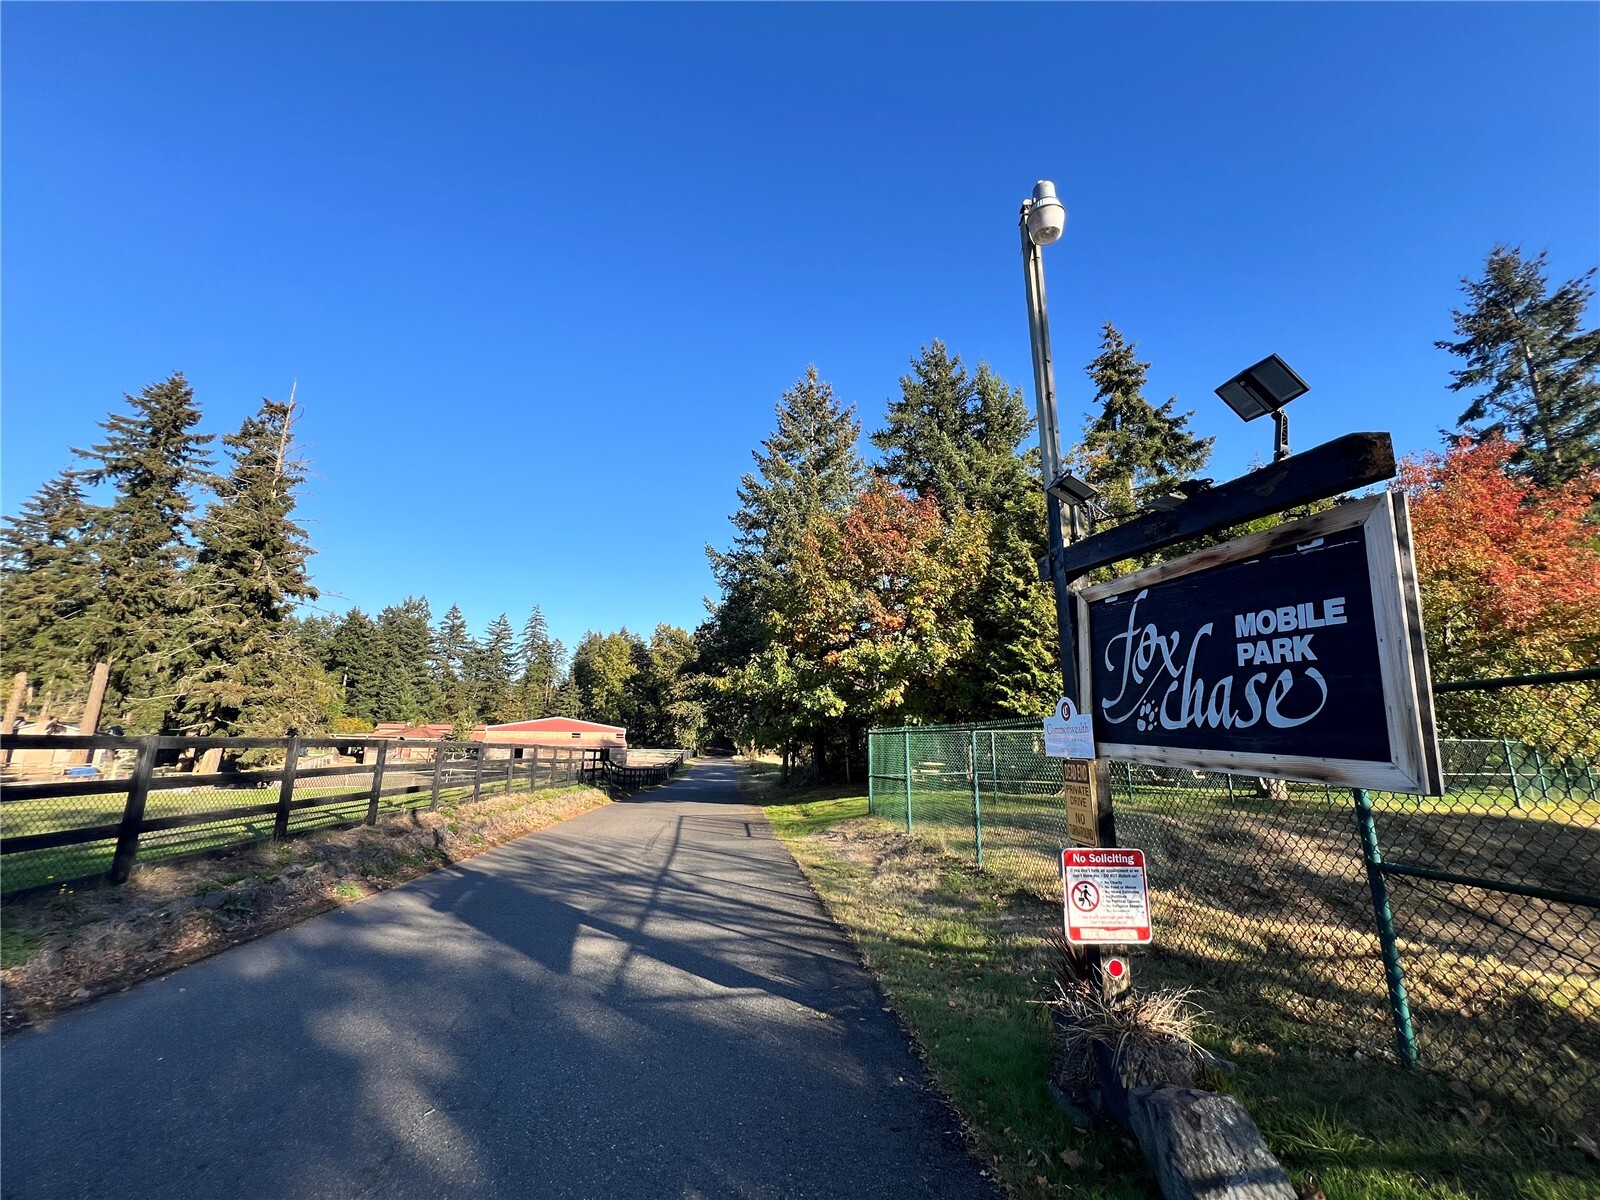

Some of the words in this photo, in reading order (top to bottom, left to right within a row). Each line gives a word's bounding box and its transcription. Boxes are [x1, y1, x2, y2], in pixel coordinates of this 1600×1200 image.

[1235, 597, 1347, 638] MOBILE
[1237, 634, 1318, 666] PARK
[1064, 764, 1076, 780] DEAD
[1077, 764, 1087, 781] END
[1066, 785, 1089, 796] PRIVATE
[1070, 796, 1087, 807] DRIVE
[1075, 813, 1085, 825] NO
[1072, 854, 1086, 863] No
[1089, 853, 1135, 865] Soliciting
